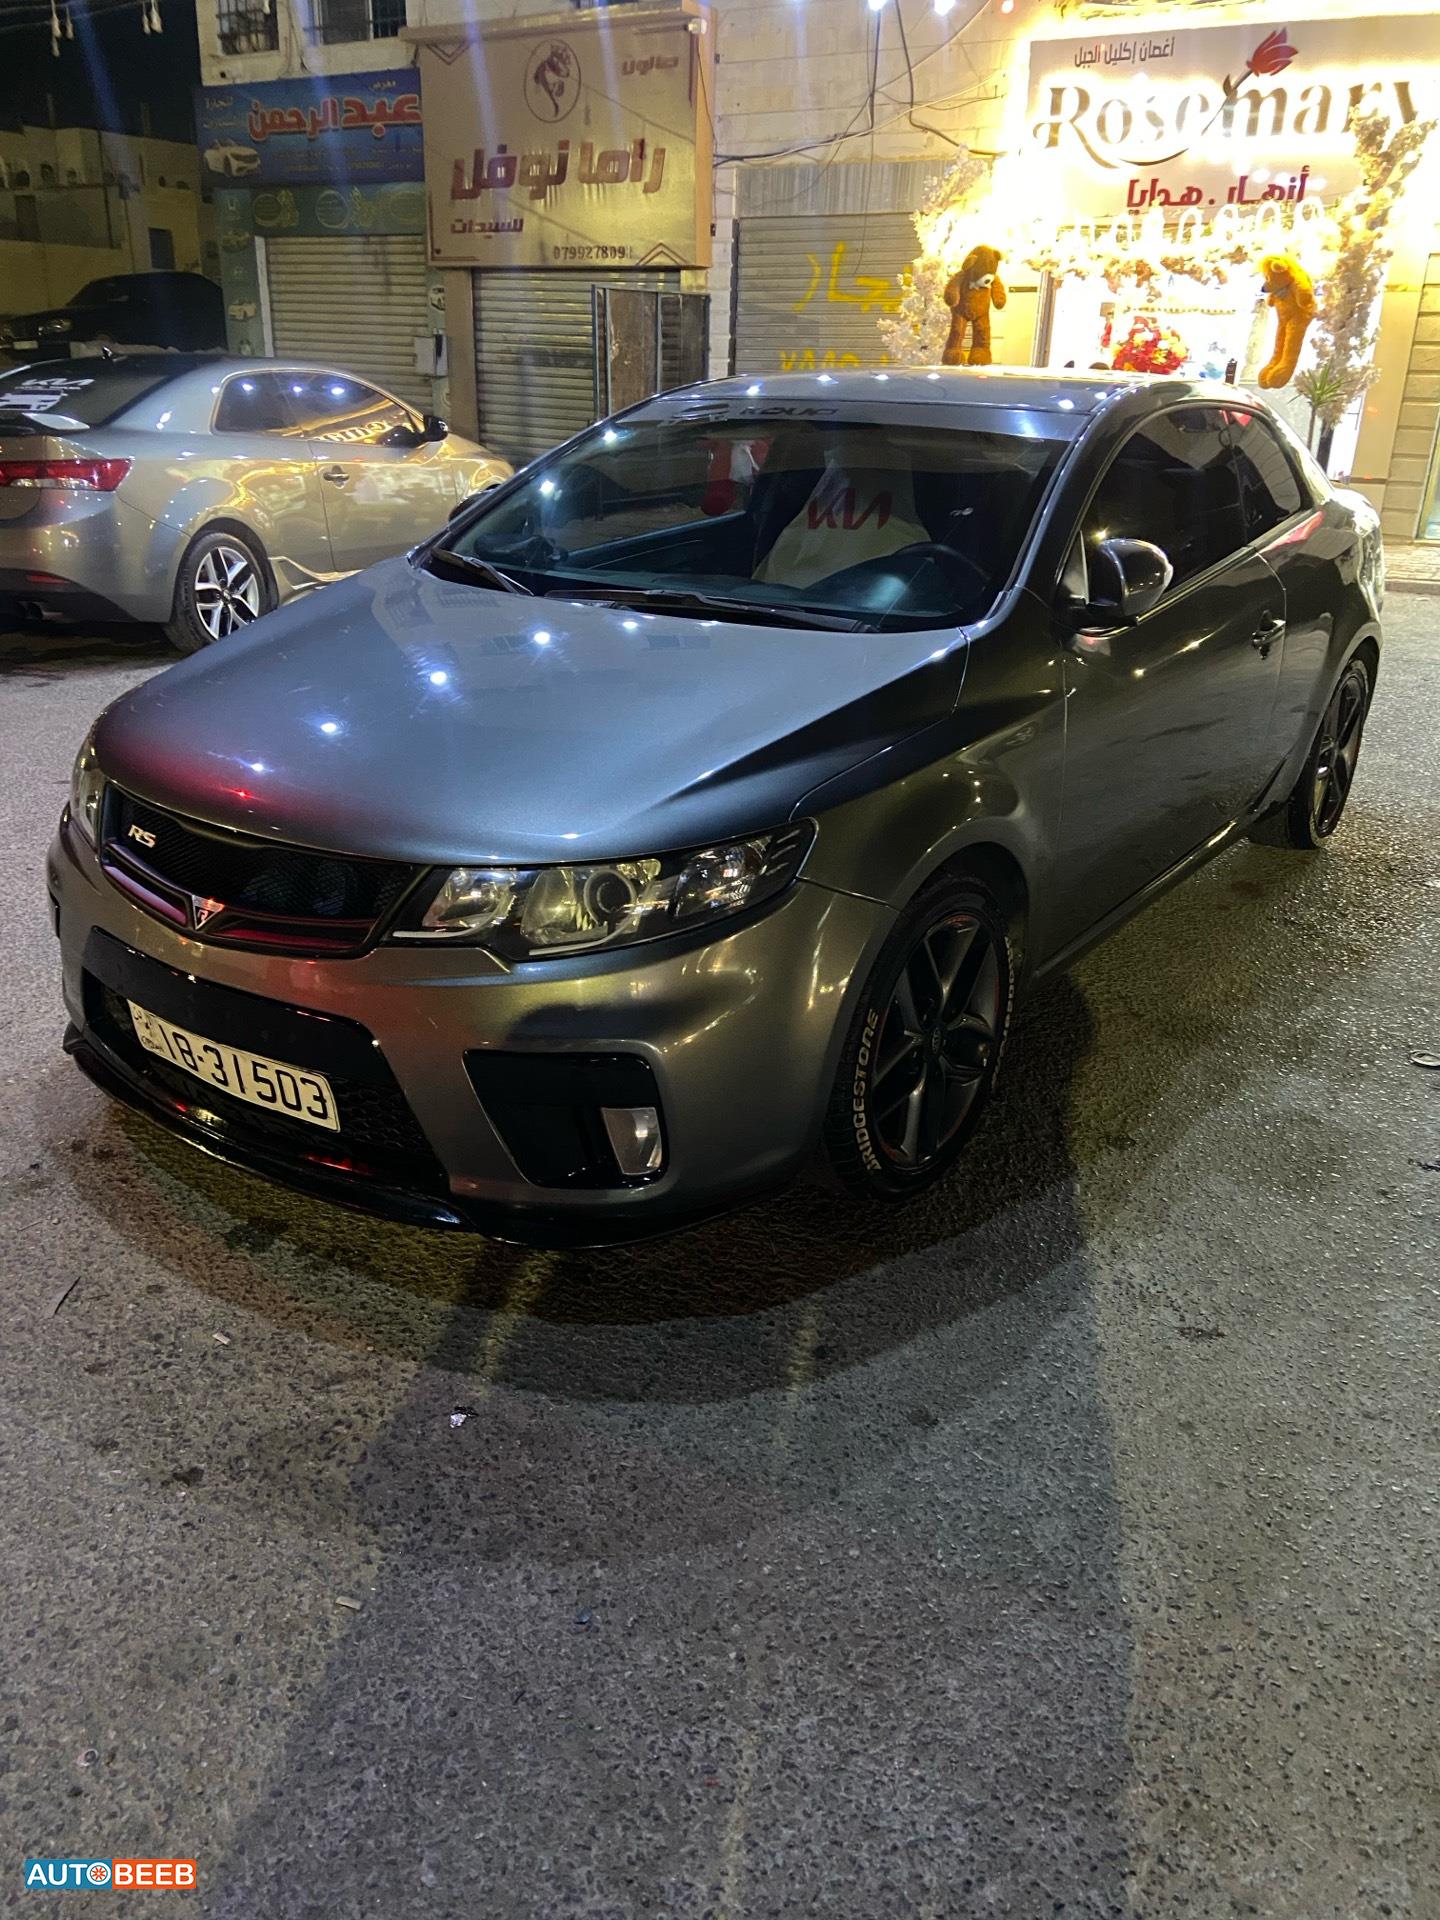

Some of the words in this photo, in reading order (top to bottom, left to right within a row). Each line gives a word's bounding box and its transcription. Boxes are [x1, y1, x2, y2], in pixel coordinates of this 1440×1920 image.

[1074, 45, 1101, 69] الجبل
[1104, 41, 1137, 65] إكليل
[1139, 36, 1175, 62] أغصان
[248, 97, 340, 142] الرحمن
[341, 93, 422, 138] عبد
[451, 139, 570, 200] نوفل
[577, 138, 667, 194] راما
[1126, 178, 1204, 216] هدايا
[450, 218, 524, 239] للسيدات
[127, 824, 157, 848] RS
[157, 1024, 329, 1120] 18-31503
[853, 1008, 882, 1171] BRIDGESTONE
